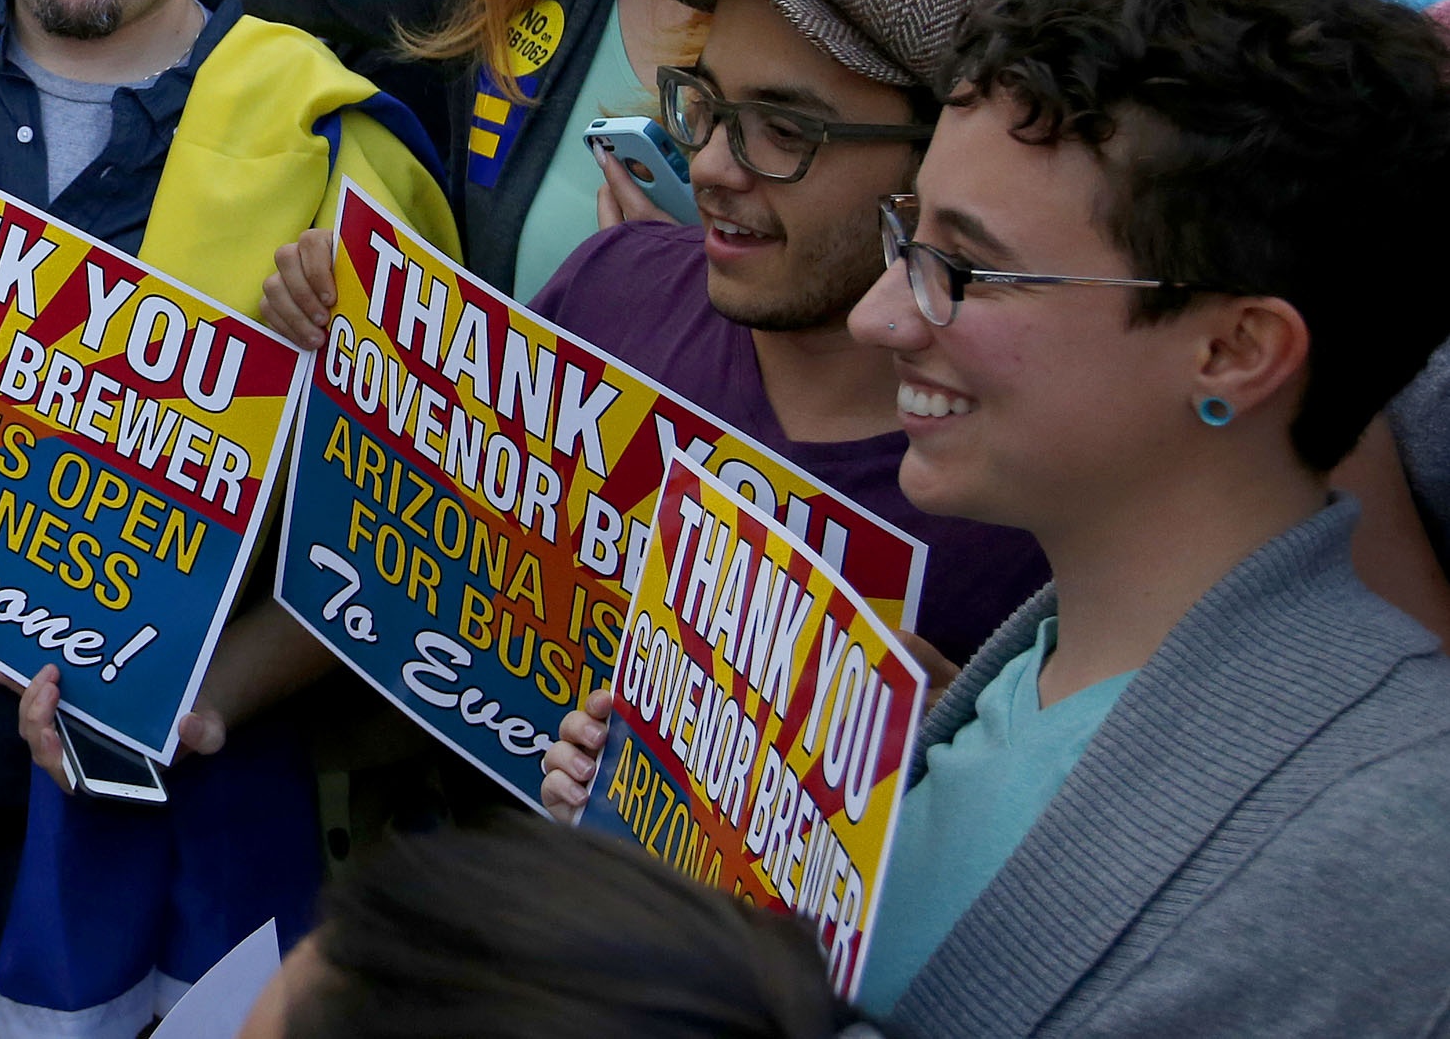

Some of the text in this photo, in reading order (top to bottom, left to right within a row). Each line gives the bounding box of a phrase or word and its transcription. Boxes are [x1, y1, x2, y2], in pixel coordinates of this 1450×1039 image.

[518, 8, 553, 44] NO on
[79, 261, 247, 414] YOU
[366, 228, 623, 480] THANK
[0, 334, 252, 516] BREWER
[323, 313, 563, 544] GOVENOR
[48, 450, 208, 574] OPEN
[308, 543, 379, 644] To
[322, 415, 547, 625] ARIZONA
[567, 580, 626, 668] IS
[346, 497, 443, 618] FOR
[662, 492, 814, 720] THANK
[801, 614, 895, 824] YOU
[605, 735, 724, 891] ARIZONA
[621, 610, 760, 829] GOVENOR
[743, 743, 865, 998] BREWER
